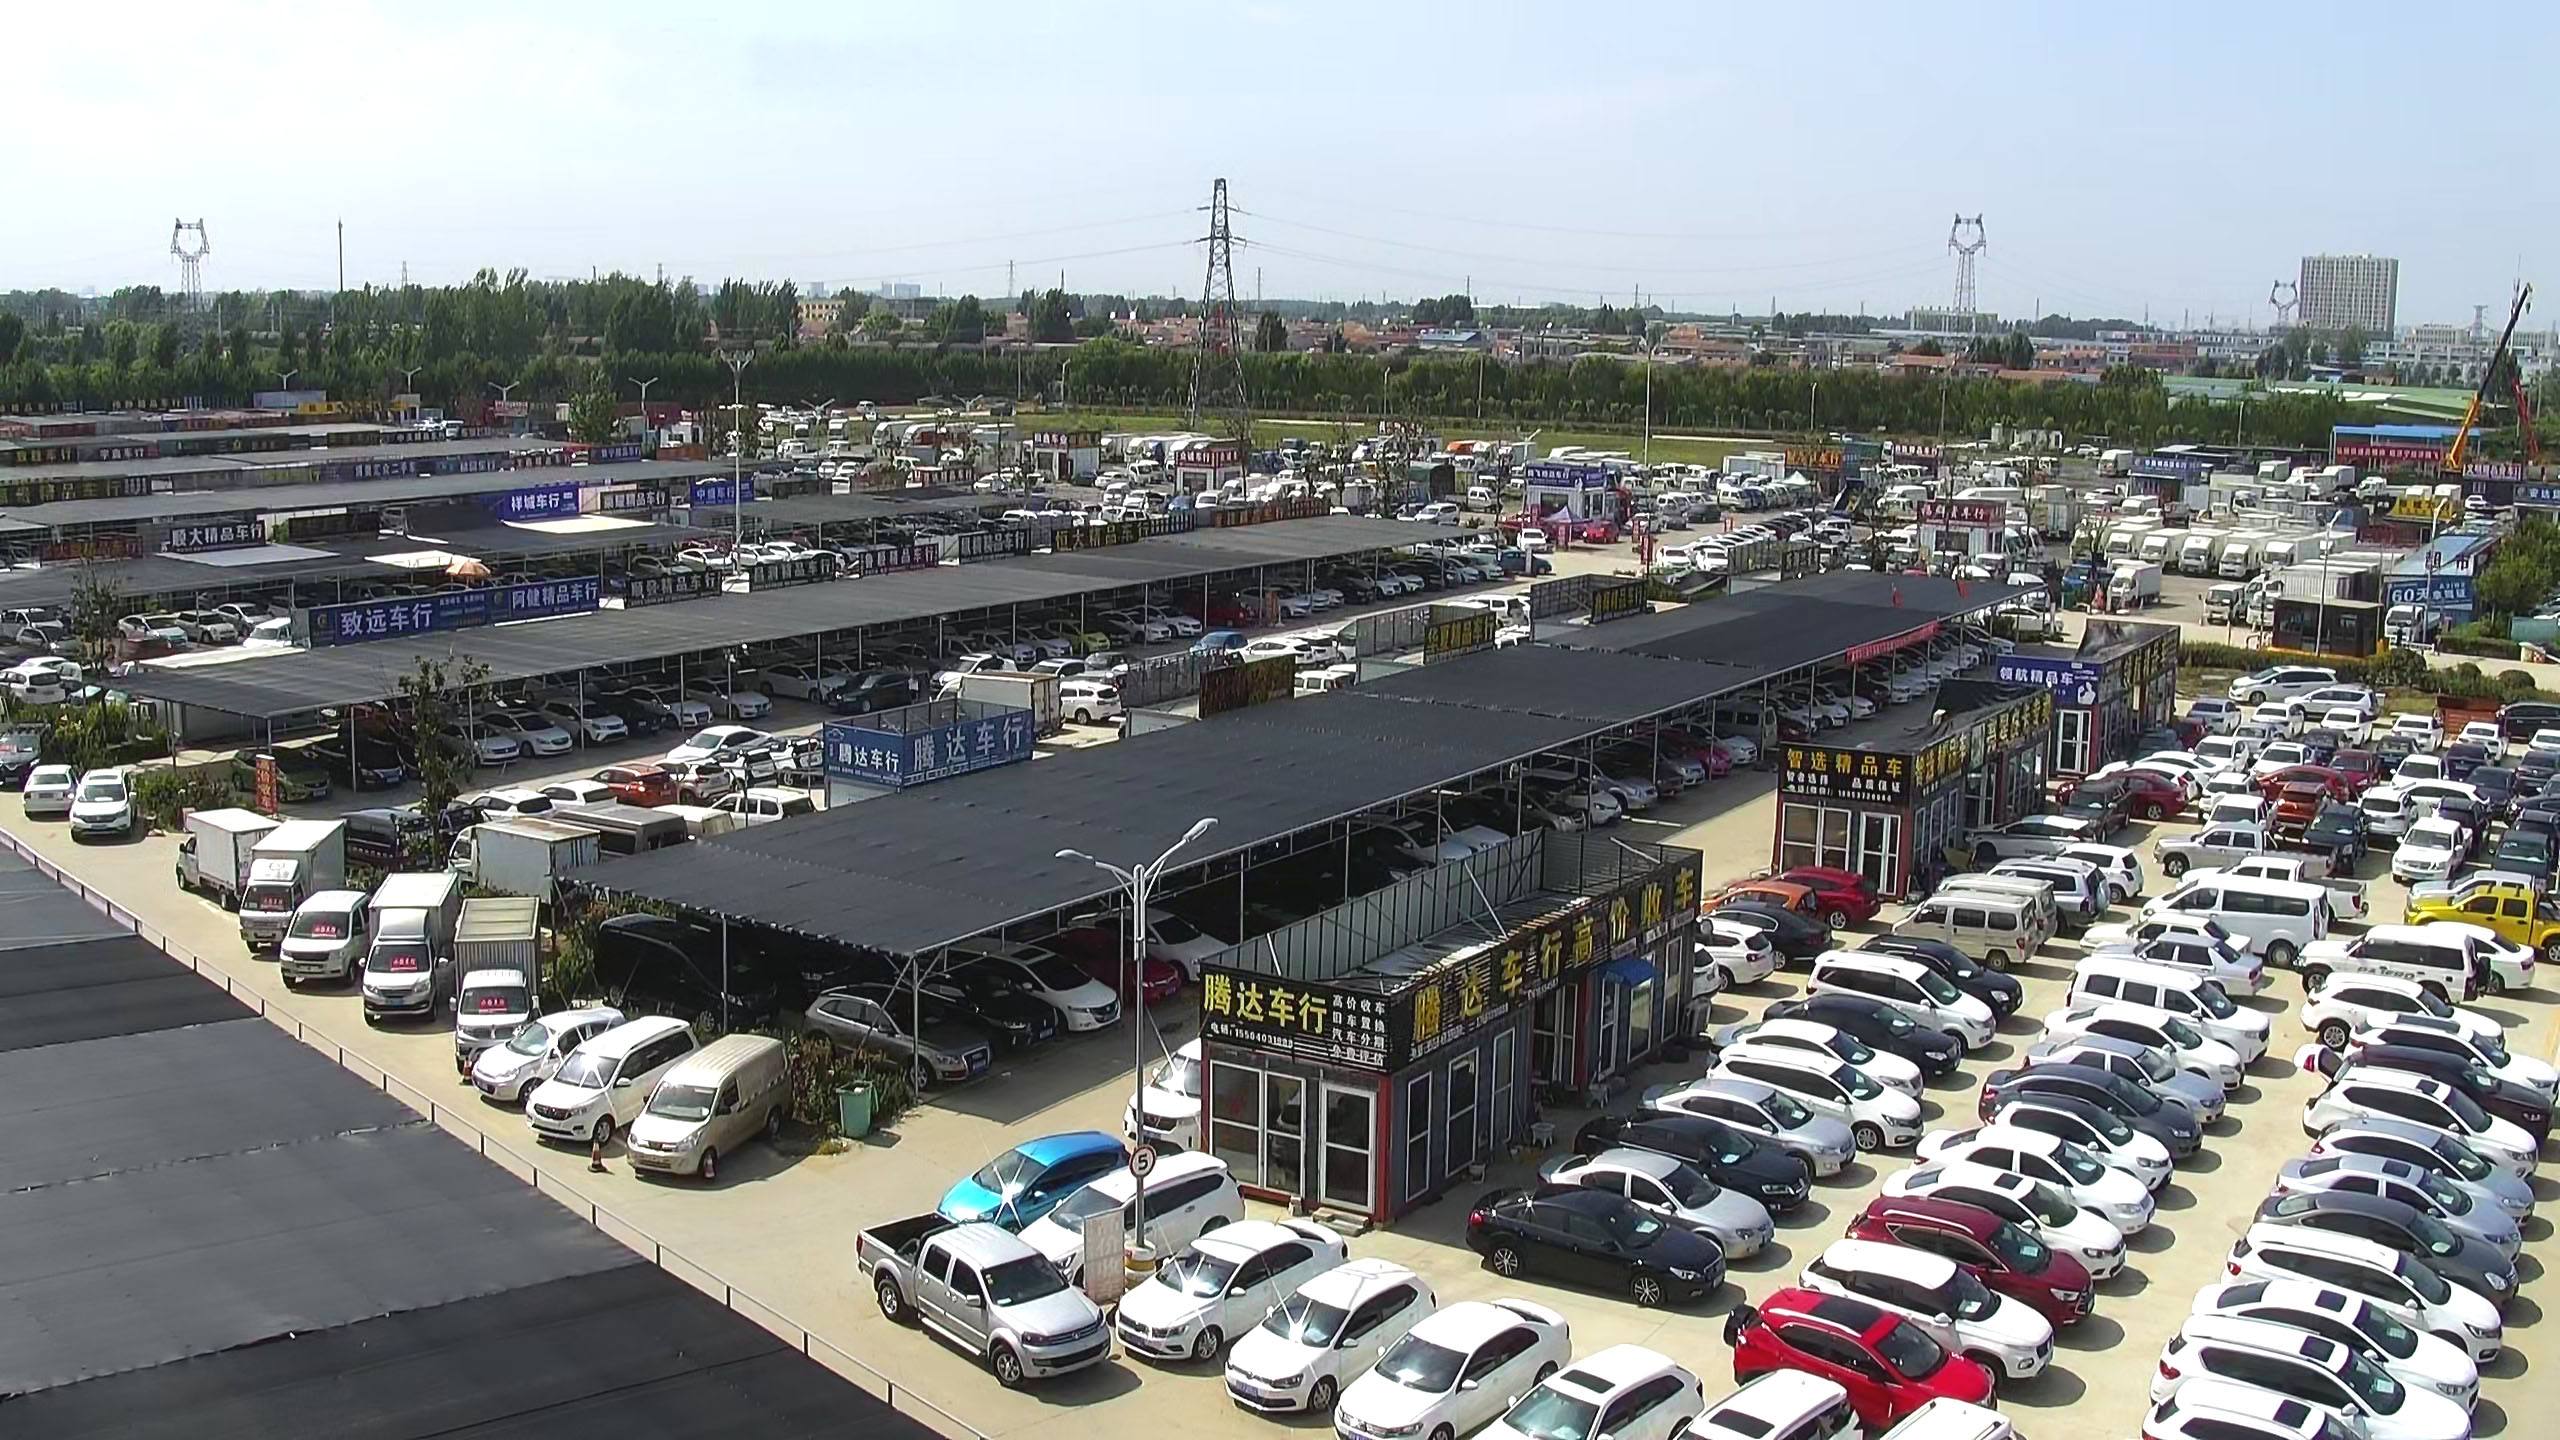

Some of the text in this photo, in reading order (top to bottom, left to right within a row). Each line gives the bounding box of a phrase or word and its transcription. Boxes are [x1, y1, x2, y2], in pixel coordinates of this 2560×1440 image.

[340, 602, 433, 637] 致远车行
[1999, 665, 2075, 687] 领航精品车
[838, 742, 900, 774] 腾达车行
[914, 716, 1024, 773] 腾达车行
[1787, 747, 1903, 779] 智选精品车
[1203, 973, 1328, 1035] 腾达车行
[1332, 993, 1386, 1016] 高价收车
[1138, 1153, 1148, 1171] 5
